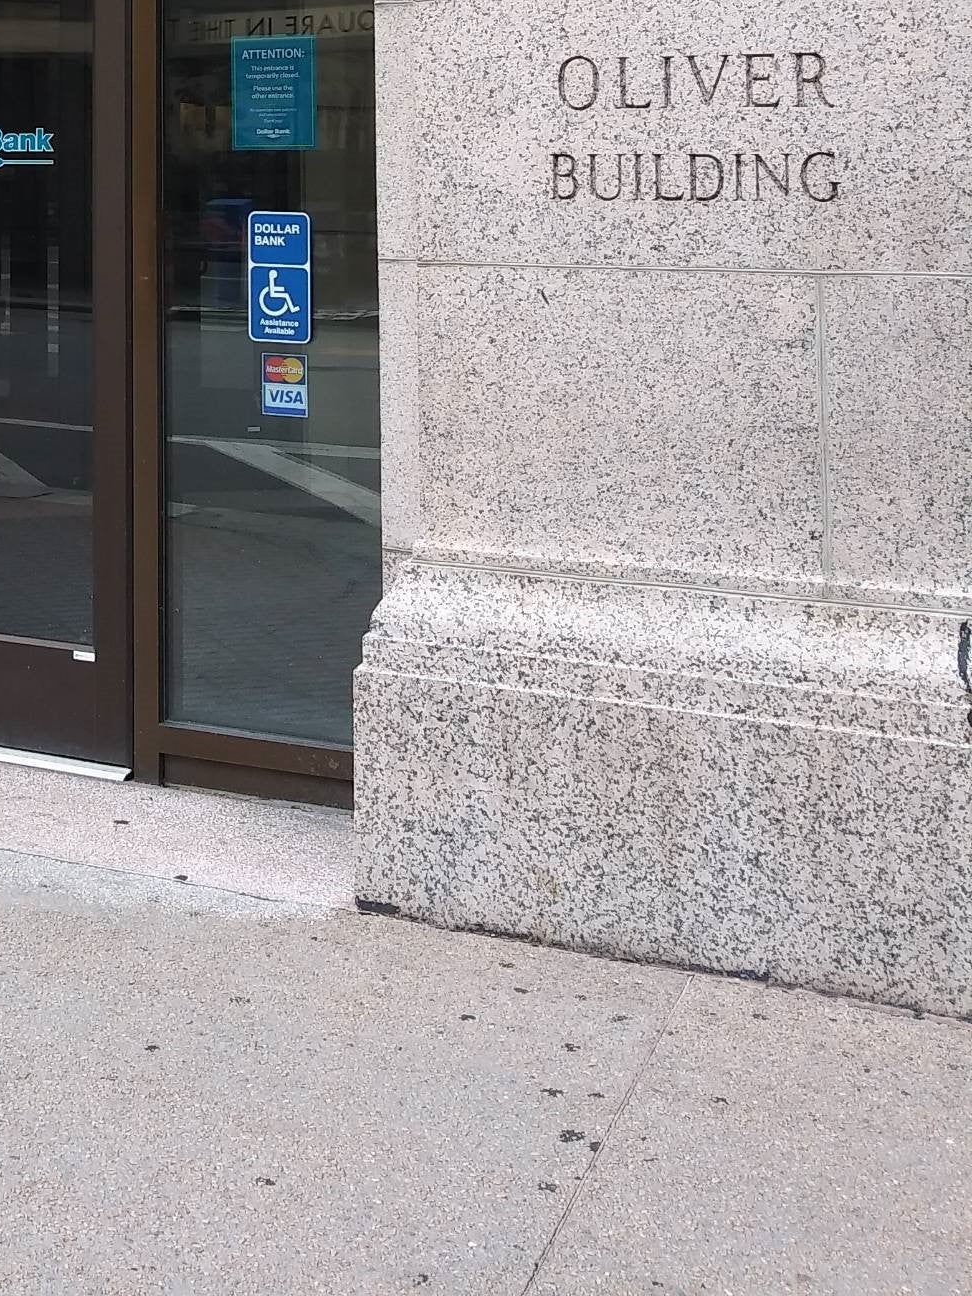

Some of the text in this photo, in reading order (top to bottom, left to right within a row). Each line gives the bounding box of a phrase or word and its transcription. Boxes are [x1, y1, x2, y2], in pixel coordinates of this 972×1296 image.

[241, 48, 305, 60] ATTENTION:
[557, 52, 836, 111] OLIVER
[549, 151, 842, 203] BUILDING
[254, 223, 300, 235] DOLLAR
[254, 235, 286, 246] BANK
[260, 318, 299, 327] Assistance
[263, 326, 295, 336] Available
[265, 364, 304, 375] MasterCard
[268, 388, 304, 405] VISA
